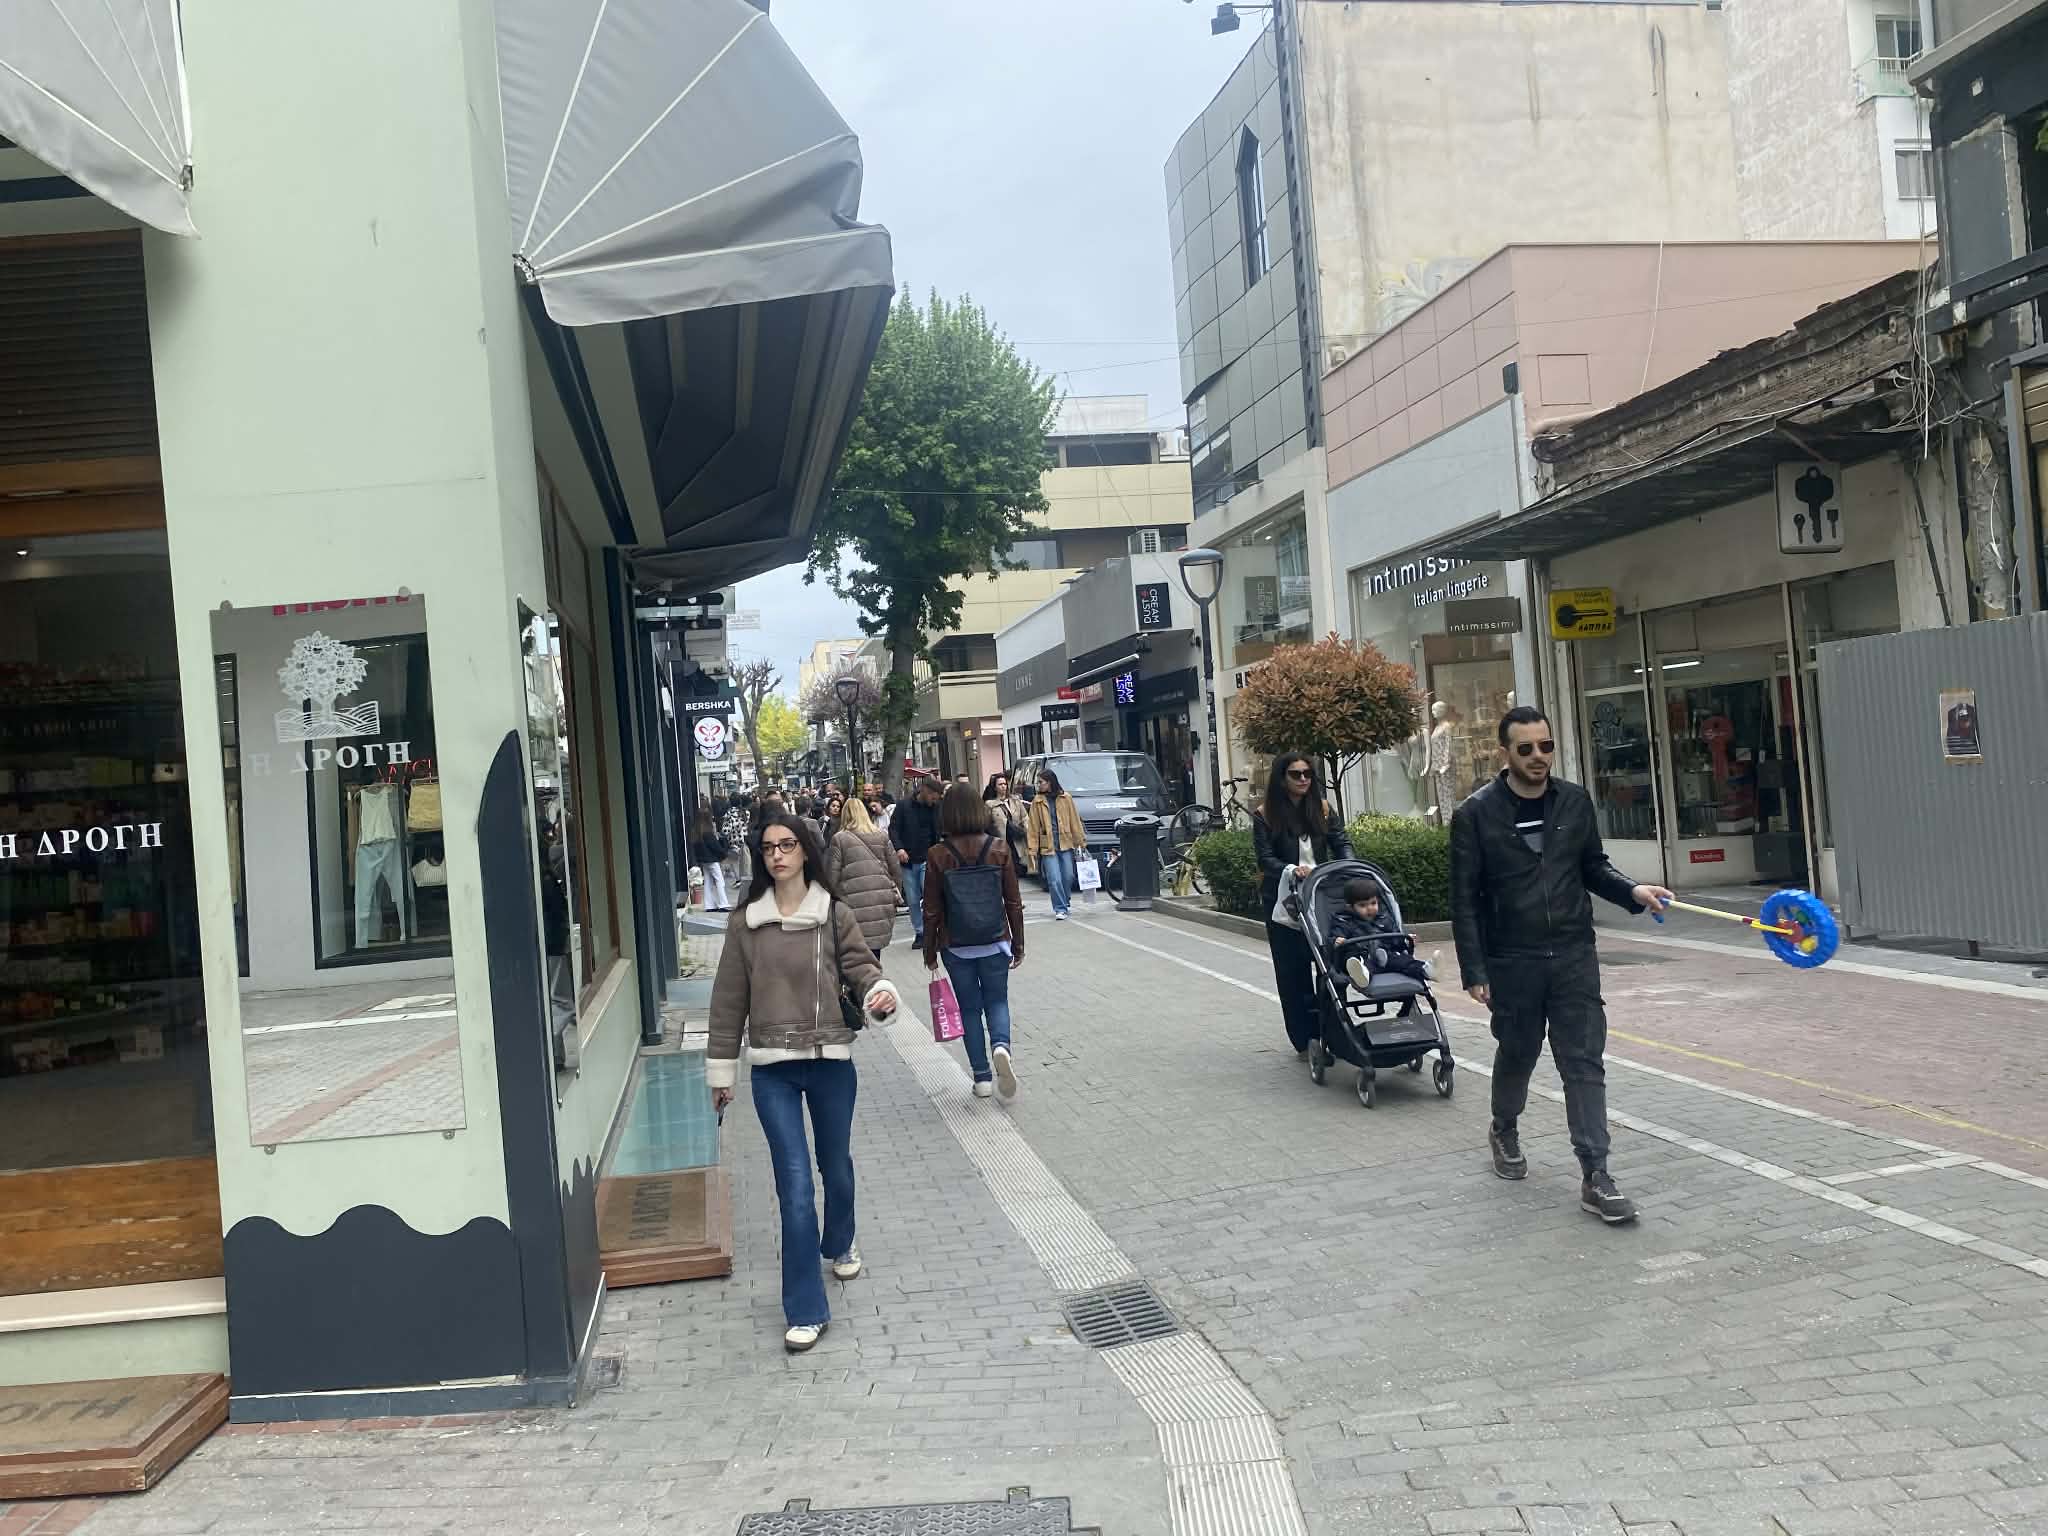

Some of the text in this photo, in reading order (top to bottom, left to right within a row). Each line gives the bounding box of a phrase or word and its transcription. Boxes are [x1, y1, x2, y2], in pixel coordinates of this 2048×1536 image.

[1150, 588, 1160, 624] CREAM
[1413, 573, 1489, 608] Italian lingerie
[1142, 599, 1151, 624] DUST
[1449, 621, 1515, 632] intimissimi
[1125, 671, 1135, 703] REAM
[685, 700, 731, 711] BERSHKA
[290, 741, 412, 773] ΔΡΟΓΗ
[36, 822, 164, 856] ΔΡΟΓΗ
